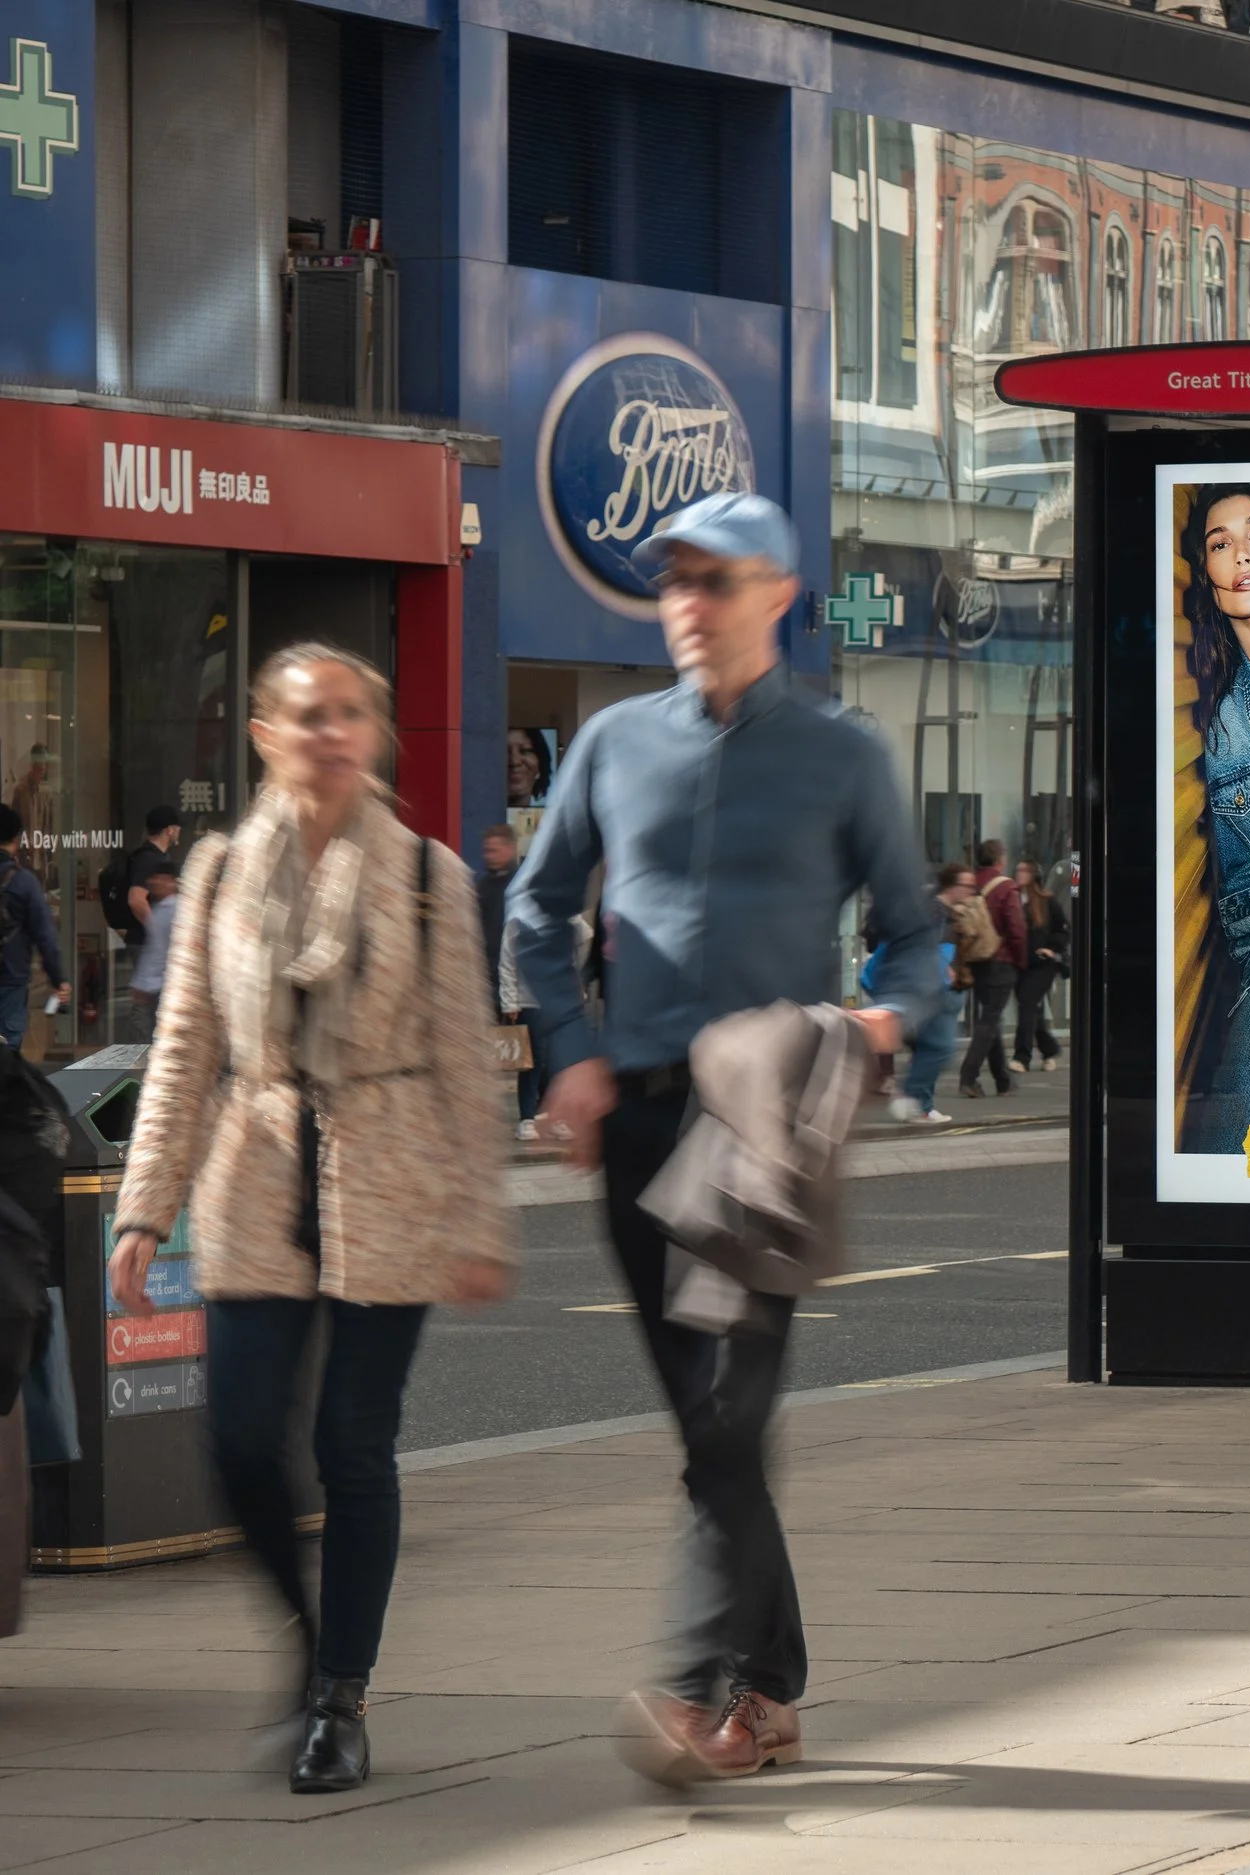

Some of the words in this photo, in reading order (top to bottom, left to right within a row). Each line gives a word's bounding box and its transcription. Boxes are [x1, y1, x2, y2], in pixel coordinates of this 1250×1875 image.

[1167, 371, 1221, 389] Great
[103, 441, 193, 515] MUJI
[587, 400, 734, 541] Boots
[198, 467, 270, 505] 無印良品
[20, 833, 29, 849] A
[33, 830, 58, 853] Day
[62, 831, 88, 849] with
[91, 830, 124, 849] MUJI
[164, 1282, 180, 1295] card
[134, 1331, 156, 1346] plastic
[157, 1329, 181, 1343] bottles
[140, 1384, 159, 1398] drink
[160, 1383, 177, 1396] cans
